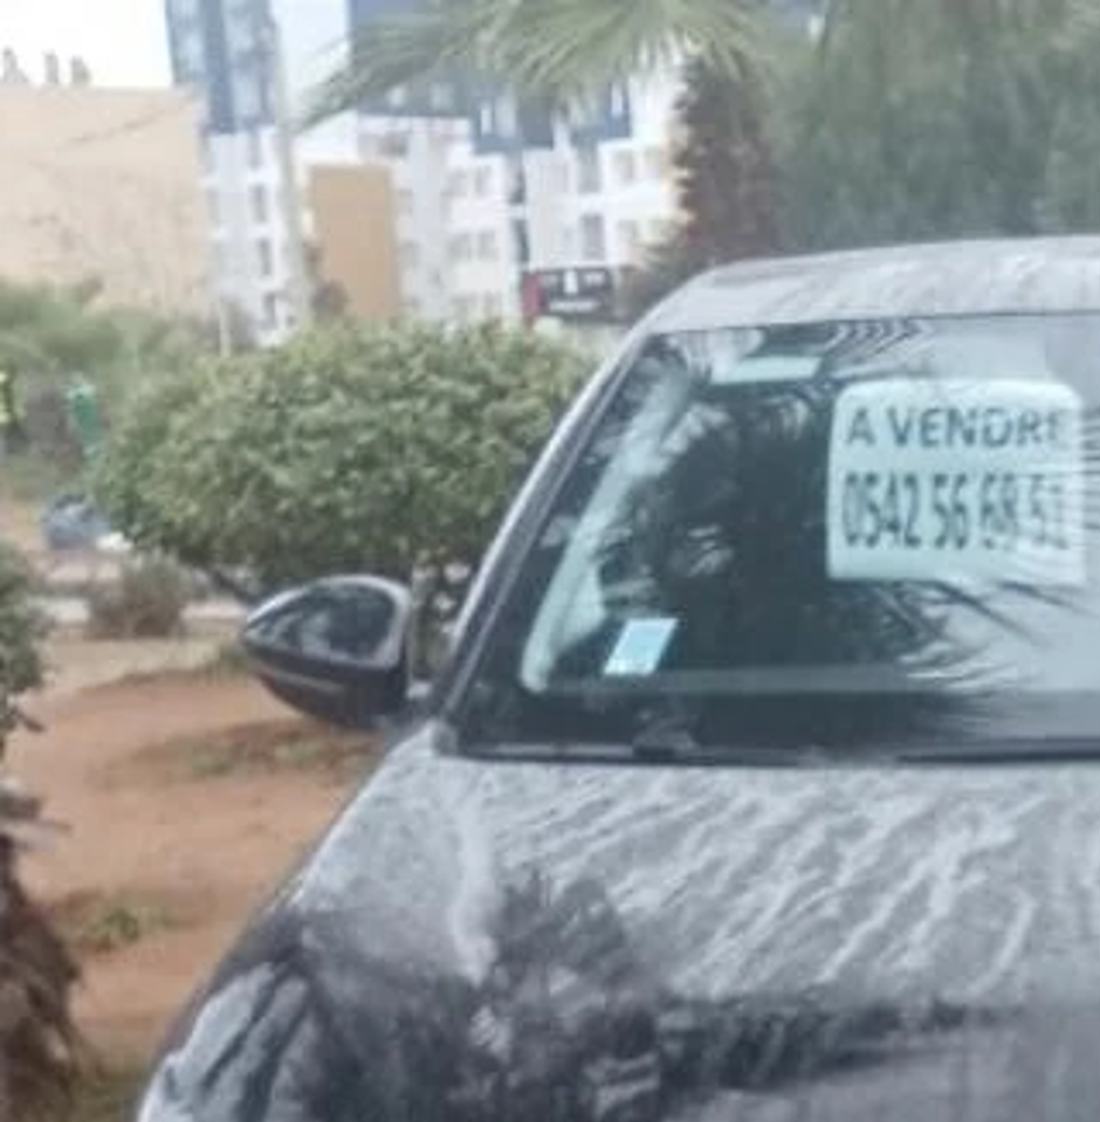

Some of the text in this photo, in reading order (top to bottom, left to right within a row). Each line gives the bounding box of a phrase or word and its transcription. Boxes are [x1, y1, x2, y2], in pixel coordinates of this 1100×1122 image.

[846, 407, 876, 446] A
[842, 472, 922, 548] 0542
[931, 472, 970, 549] 56
